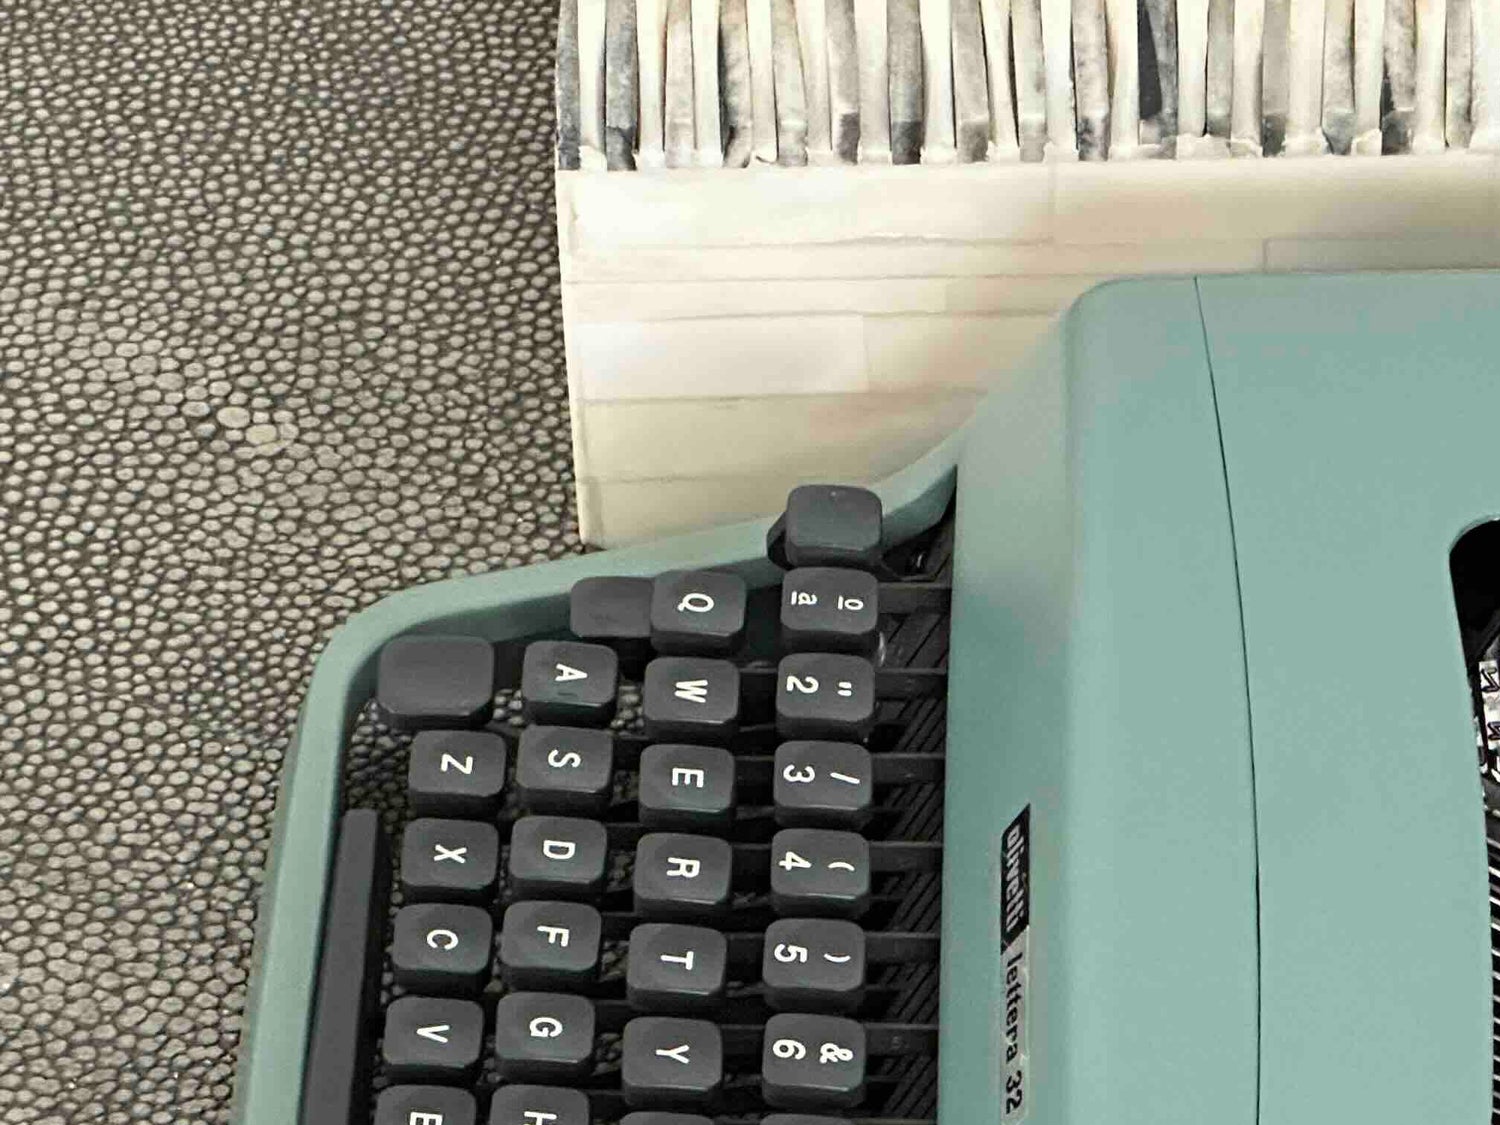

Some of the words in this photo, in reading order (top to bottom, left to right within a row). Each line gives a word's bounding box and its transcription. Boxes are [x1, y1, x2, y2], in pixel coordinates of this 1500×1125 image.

[677, 592, 715, 613] Q
[555, 663, 588, 682] A
[674, 679, 709, 703] W
[786, 675, 819, 694] 2
[440, 753, 474, 775] Z
[547, 749, 582, 768] S
[671, 767, 705, 788] E
[783, 764, 816, 783] 3
[433, 844, 467, 864] X
[542, 839, 576, 860] D
[666, 857, 701, 878] R
[778, 851, 812, 871] 4
[1006, 824, 1024, 932] olivetti
[426, 929, 459, 951] C
[536, 925, 570, 947] F
[660, 950, 694, 971] T
[774, 943, 808, 963] 5
[1005, 952, 1023, 1064] lettera
[416, 1024, 450, 1044] V
[529, 1016, 563, 1038] G
[655, 1044, 690, 1064] Y
[772, 1039, 807, 1060] 6
[819, 1042, 854, 1064] &
[1005, 1069, 1023, 1114] 32
